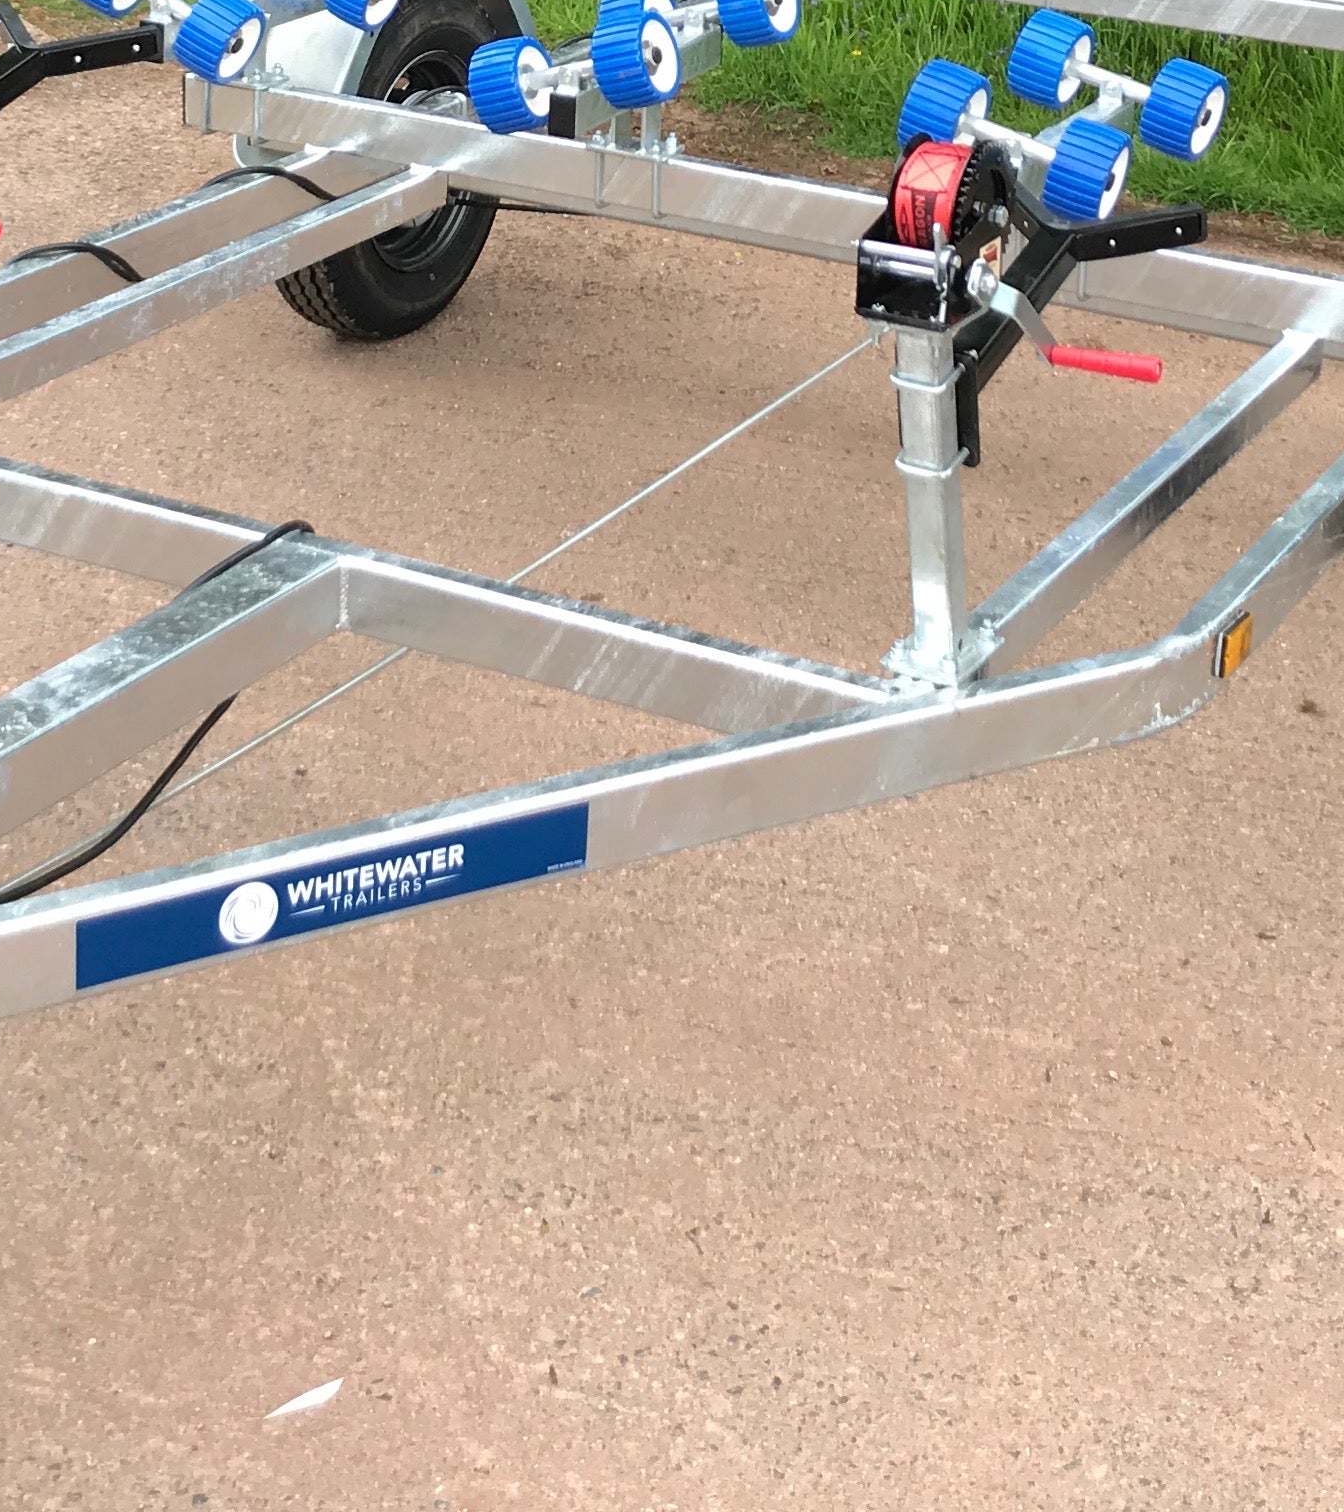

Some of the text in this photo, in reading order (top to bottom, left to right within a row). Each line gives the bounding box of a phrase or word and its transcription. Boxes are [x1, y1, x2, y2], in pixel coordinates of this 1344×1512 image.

[914, 194, 928, 247] AGON
[287, 843, 465, 906] WHITEWATER
[330, 876, 422, 912] TRAILERS
